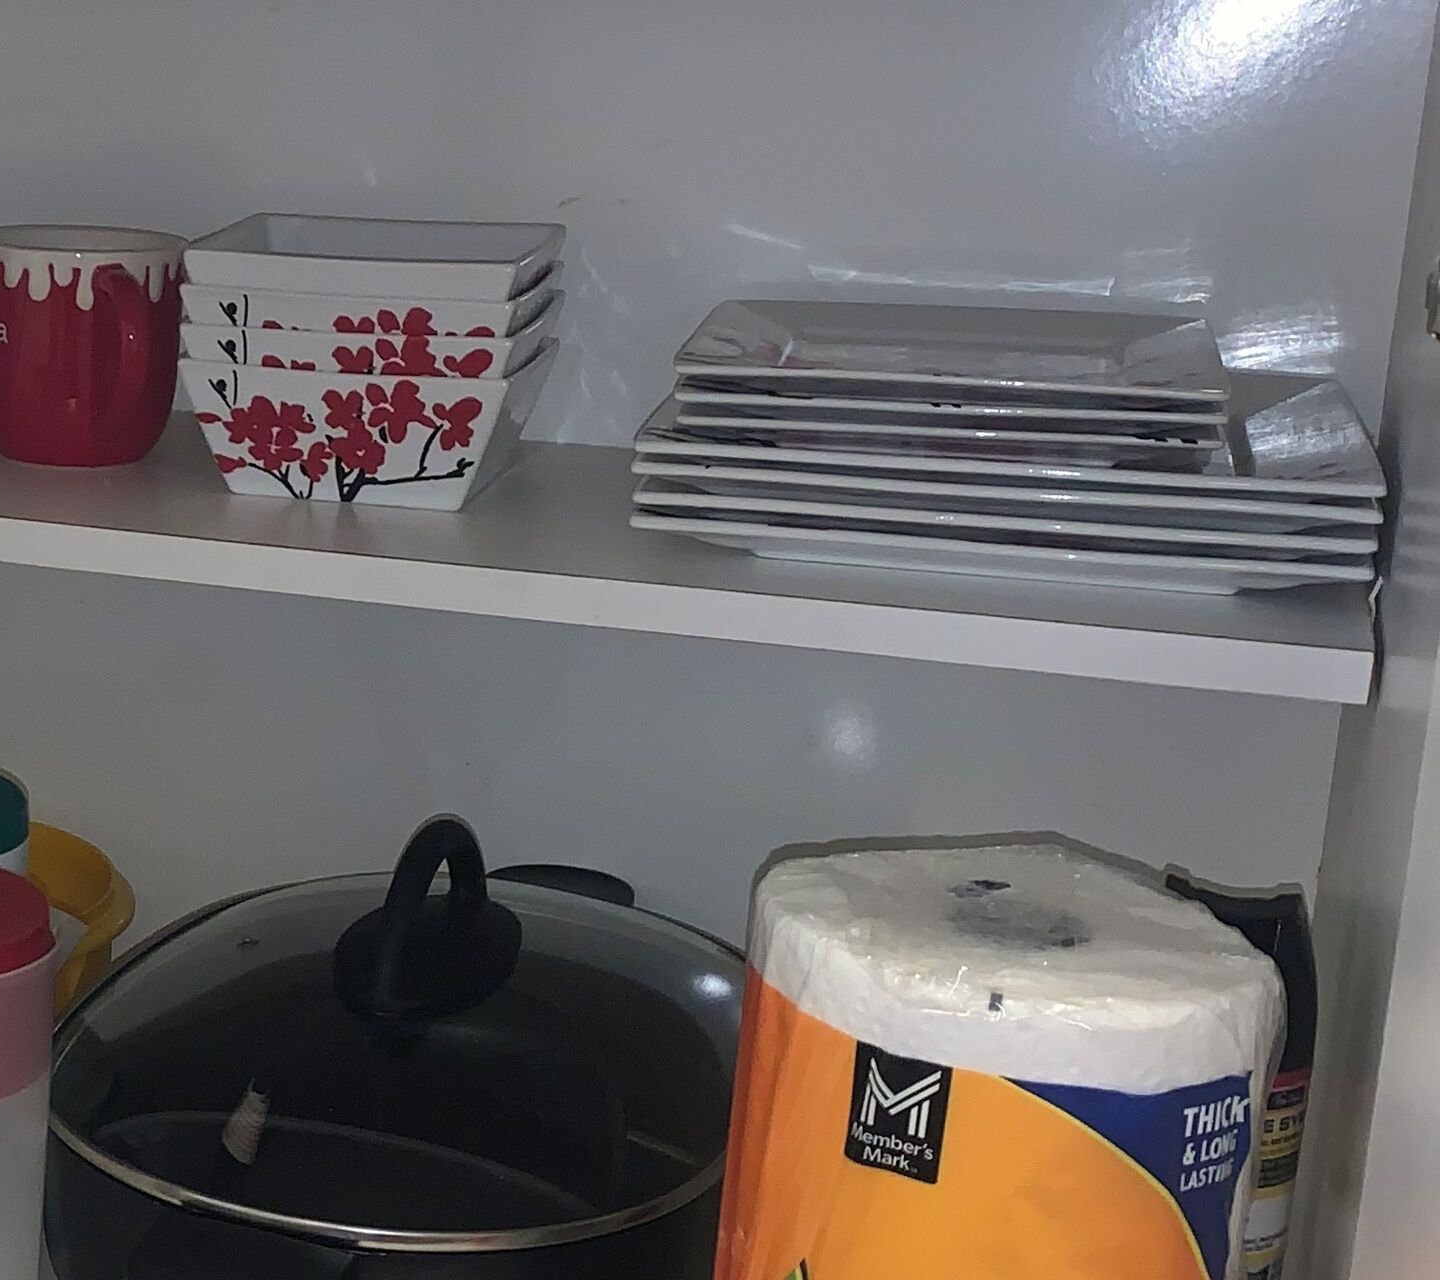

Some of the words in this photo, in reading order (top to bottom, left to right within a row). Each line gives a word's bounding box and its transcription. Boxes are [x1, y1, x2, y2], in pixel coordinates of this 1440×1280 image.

[1183, 1095, 1251, 1138] THICK
[850, 1121, 934, 1160] Member's
[1182, 1142, 1197, 1166] &
[862, 1145, 910, 1171] Mark
